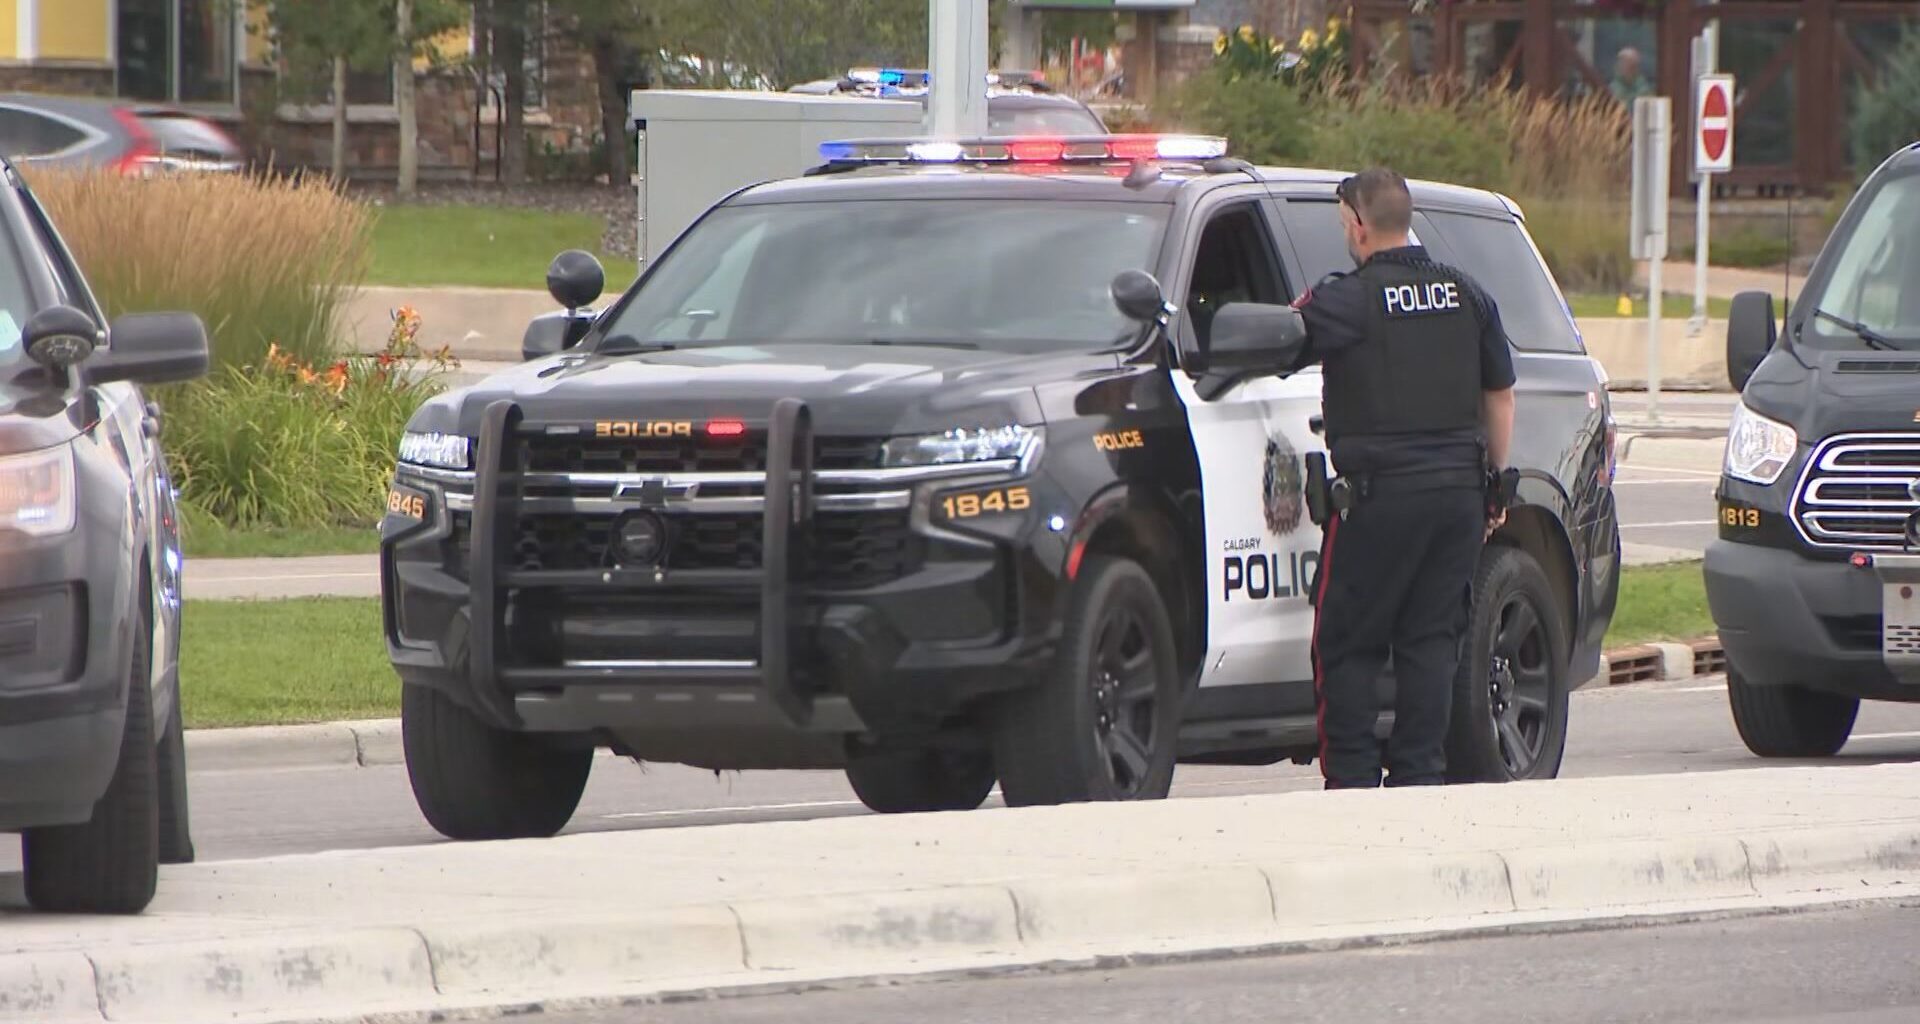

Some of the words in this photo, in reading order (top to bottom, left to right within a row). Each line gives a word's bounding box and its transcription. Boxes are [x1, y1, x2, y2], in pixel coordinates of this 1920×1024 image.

[1384, 282, 1460, 313] POLICE
[1092, 430, 1144, 452] POLICE
[943, 487, 1031, 519] 1845
[1721, 507, 1760, 527] 1813
[1223, 538, 1261, 551] CALGARY
[1223, 550, 1321, 602] POLIC
